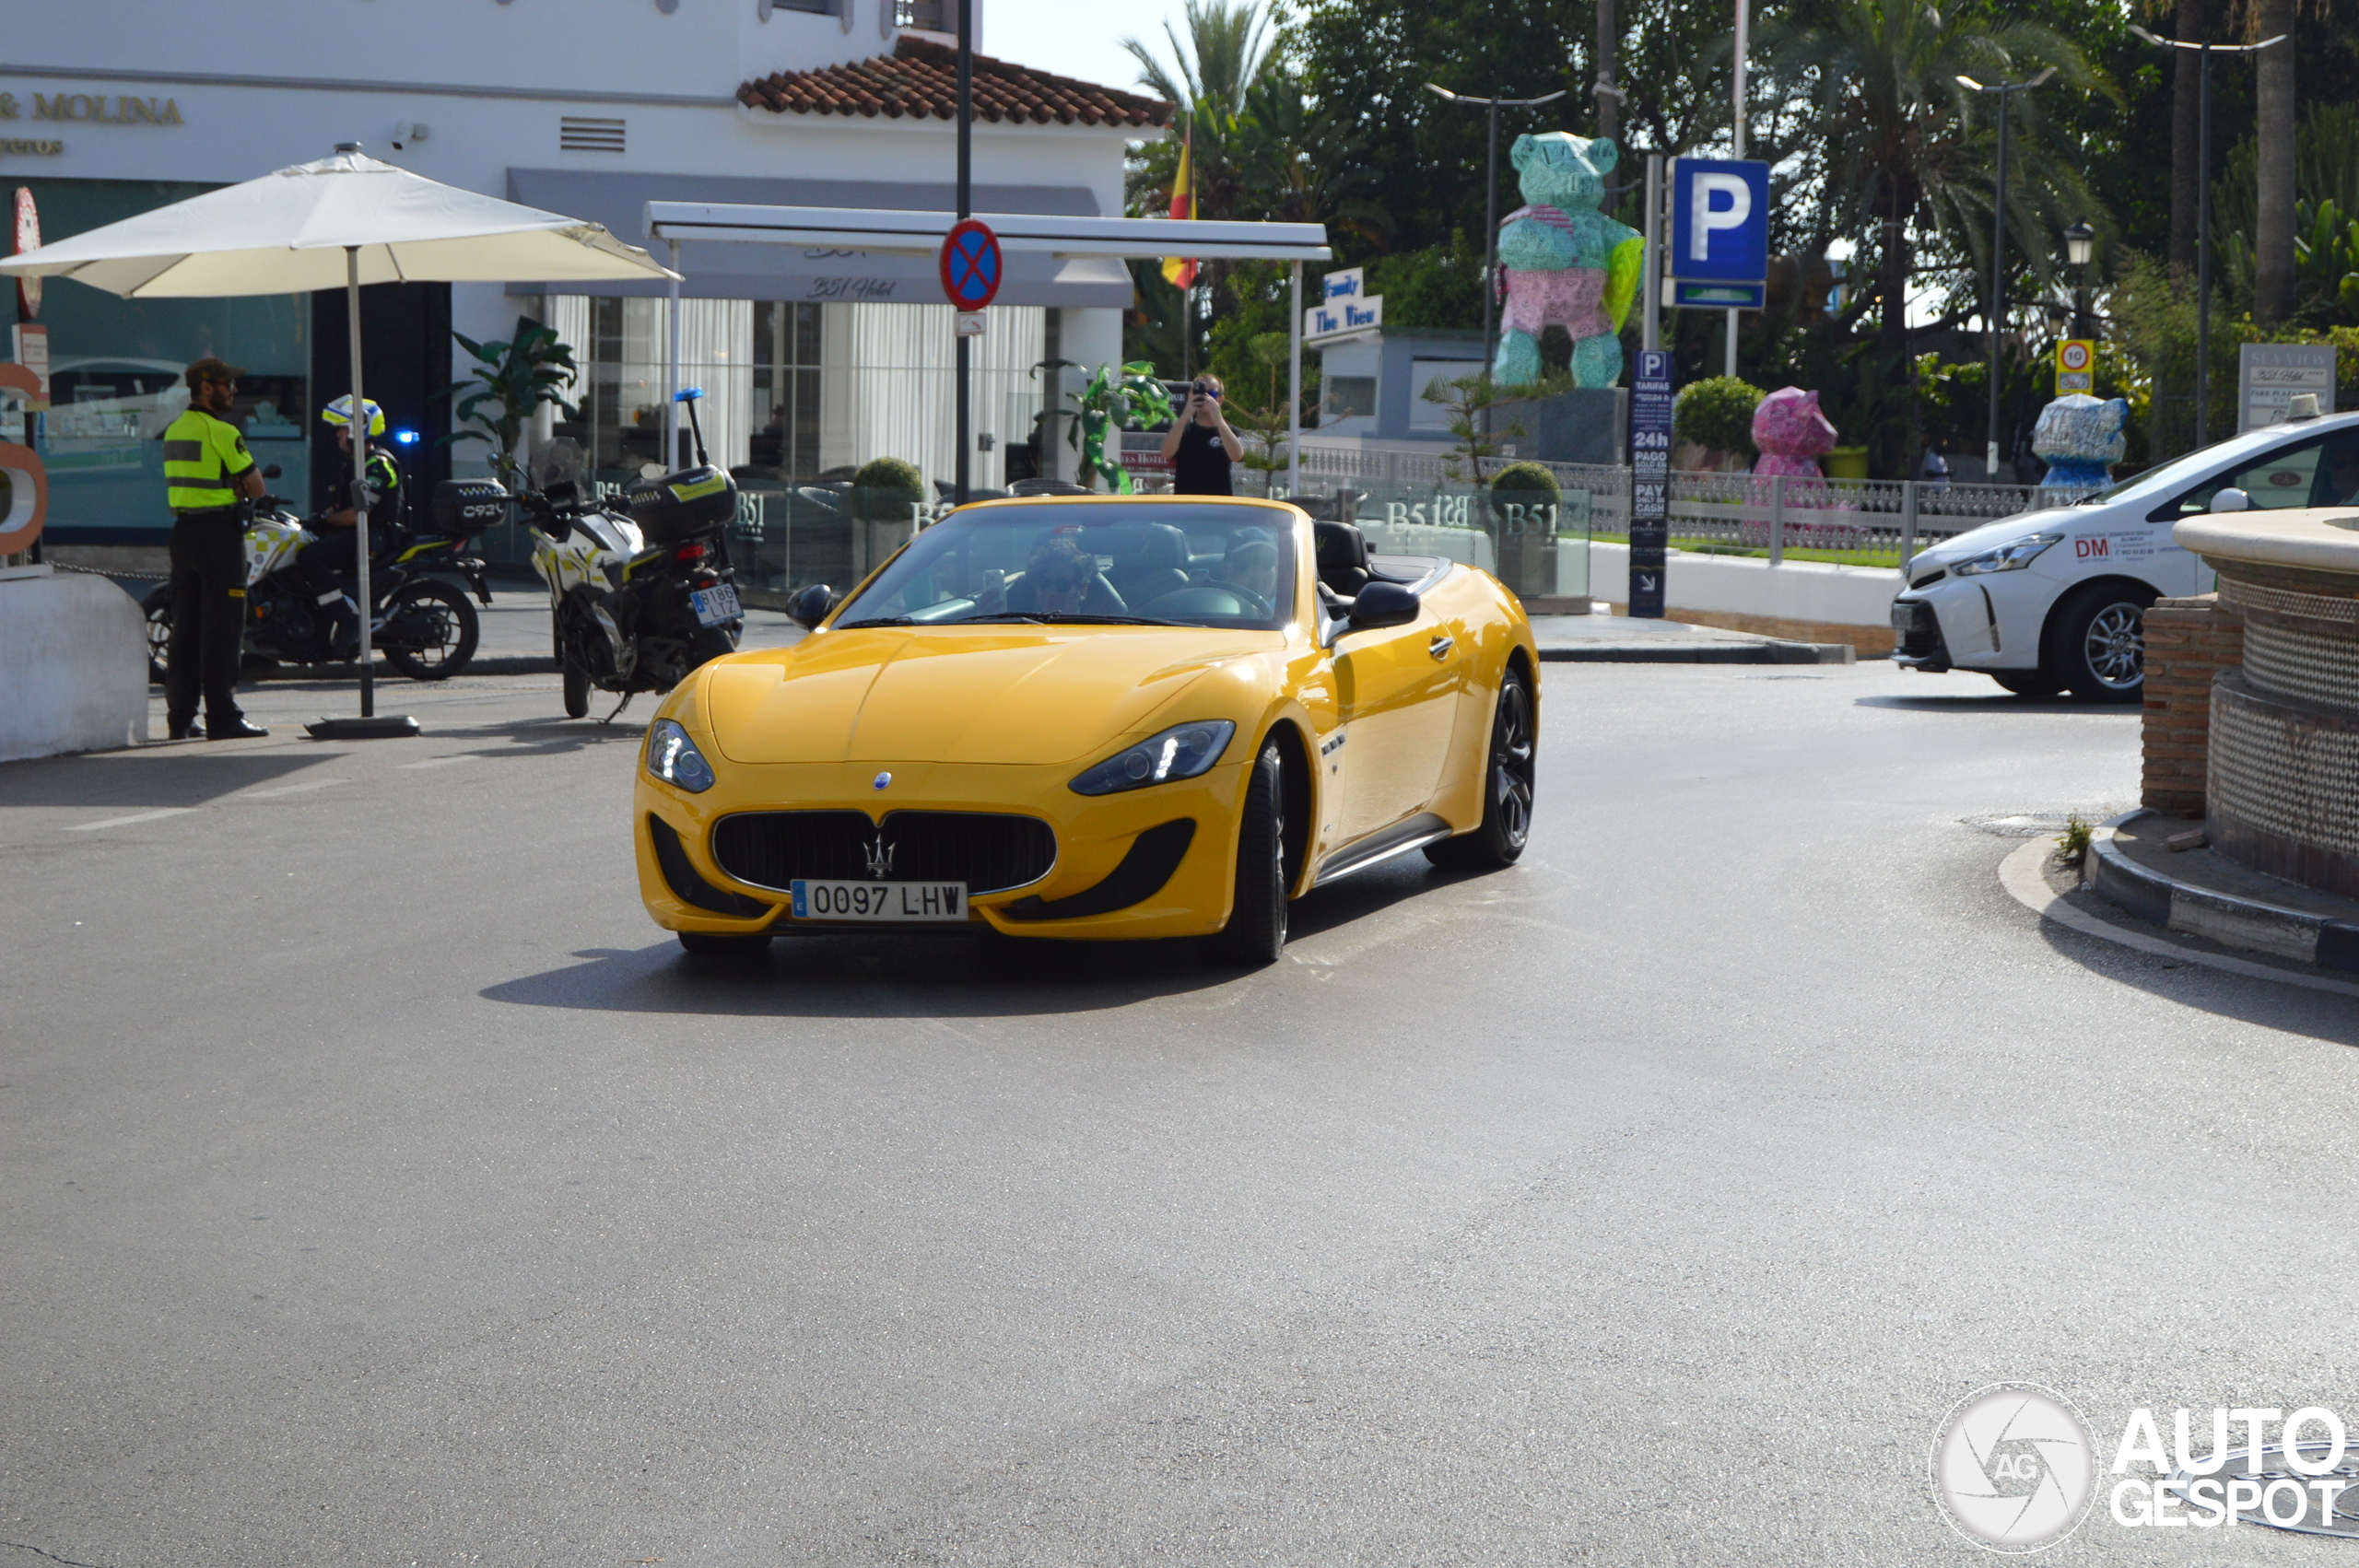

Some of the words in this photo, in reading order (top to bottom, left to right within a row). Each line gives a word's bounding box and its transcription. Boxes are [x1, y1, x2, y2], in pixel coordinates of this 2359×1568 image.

[32, 93, 184, 124] MOLINA
[1690, 172, 1752, 262] P
[851, 278, 897, 298] Hotel
[1324, 275, 1359, 298] Family
[1316, 310, 1338, 333] The
[1345, 304, 1375, 326] View
[1645, 354, 1661, 376] P
[2069, 351, 2083, 360] 10
[1636, 381, 1670, 390] TARIFAS
[1635, 451, 1667, 461] PAGO
[1636, 484, 1665, 496] PAY
[737, 492, 765, 527] B51
[1386, 502, 1441, 534] B51
[1636, 504, 1665, 512] CASH
[1505, 503, 1558, 535] B51
[2075, 539, 2108, 557] DM
[701, 586, 734, 604] 8186
[710, 600, 736, 617] LTZ
[814, 885, 888, 915] 0097
[901, 886, 959, 915] LHW
